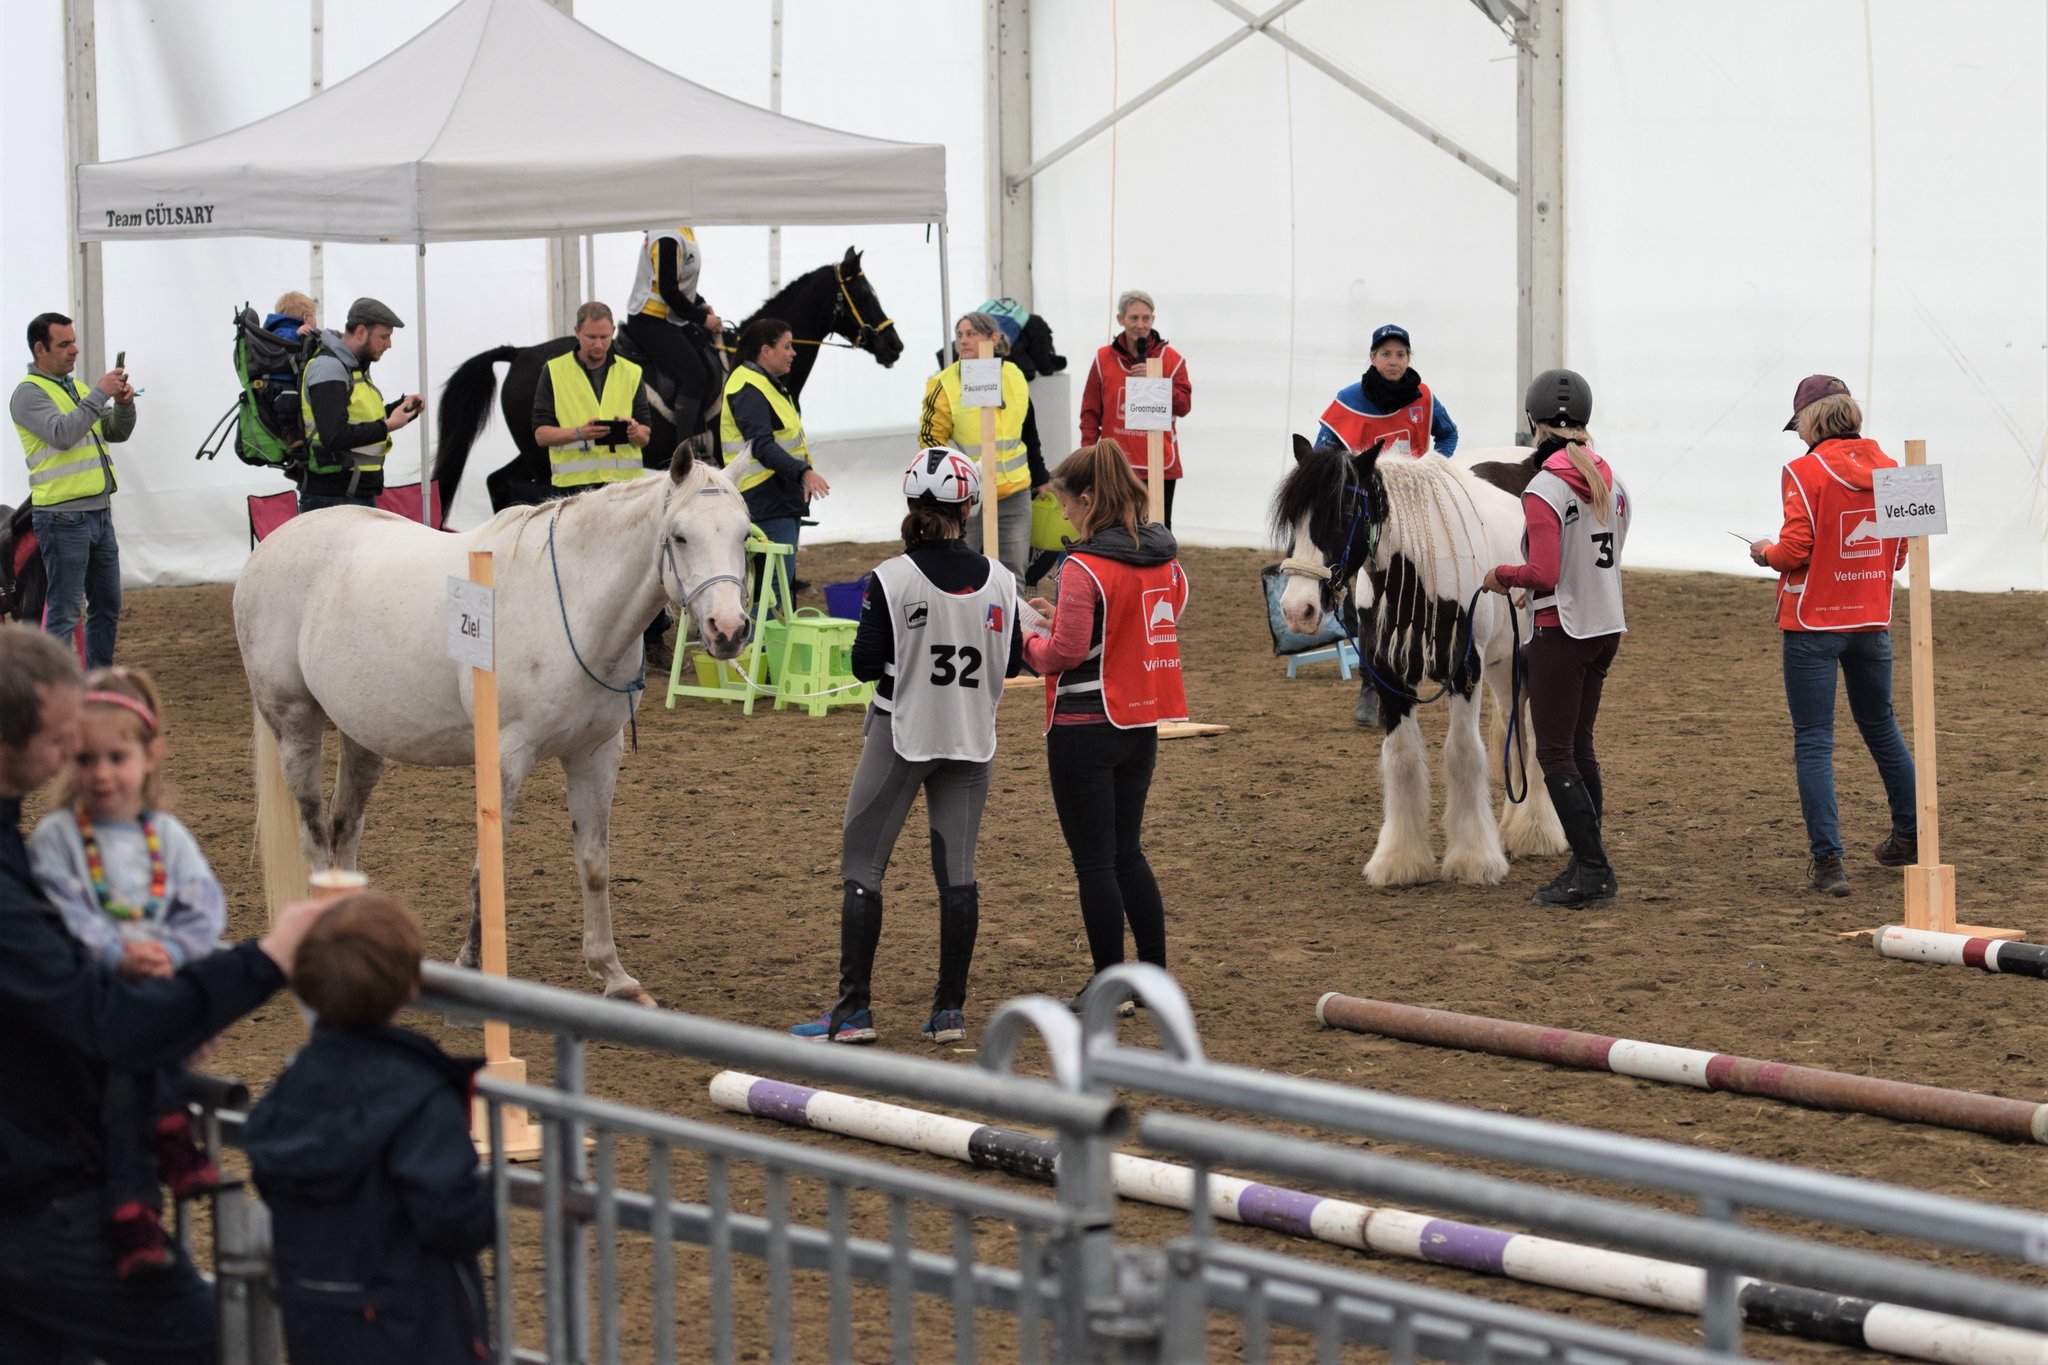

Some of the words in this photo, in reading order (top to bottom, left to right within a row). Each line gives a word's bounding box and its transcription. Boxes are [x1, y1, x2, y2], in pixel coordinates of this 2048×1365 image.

[106, 210, 142, 227] Team
[145, 203, 215, 226] GÜLSARY
[963, 383, 998, 392] Pausenplatz
[1129, 404, 1168, 415] Groomplatz
[1885, 503, 1936, 518] Vet-Gate
[461, 613, 480, 638] Ziel
[930, 645, 982, 689] 32
